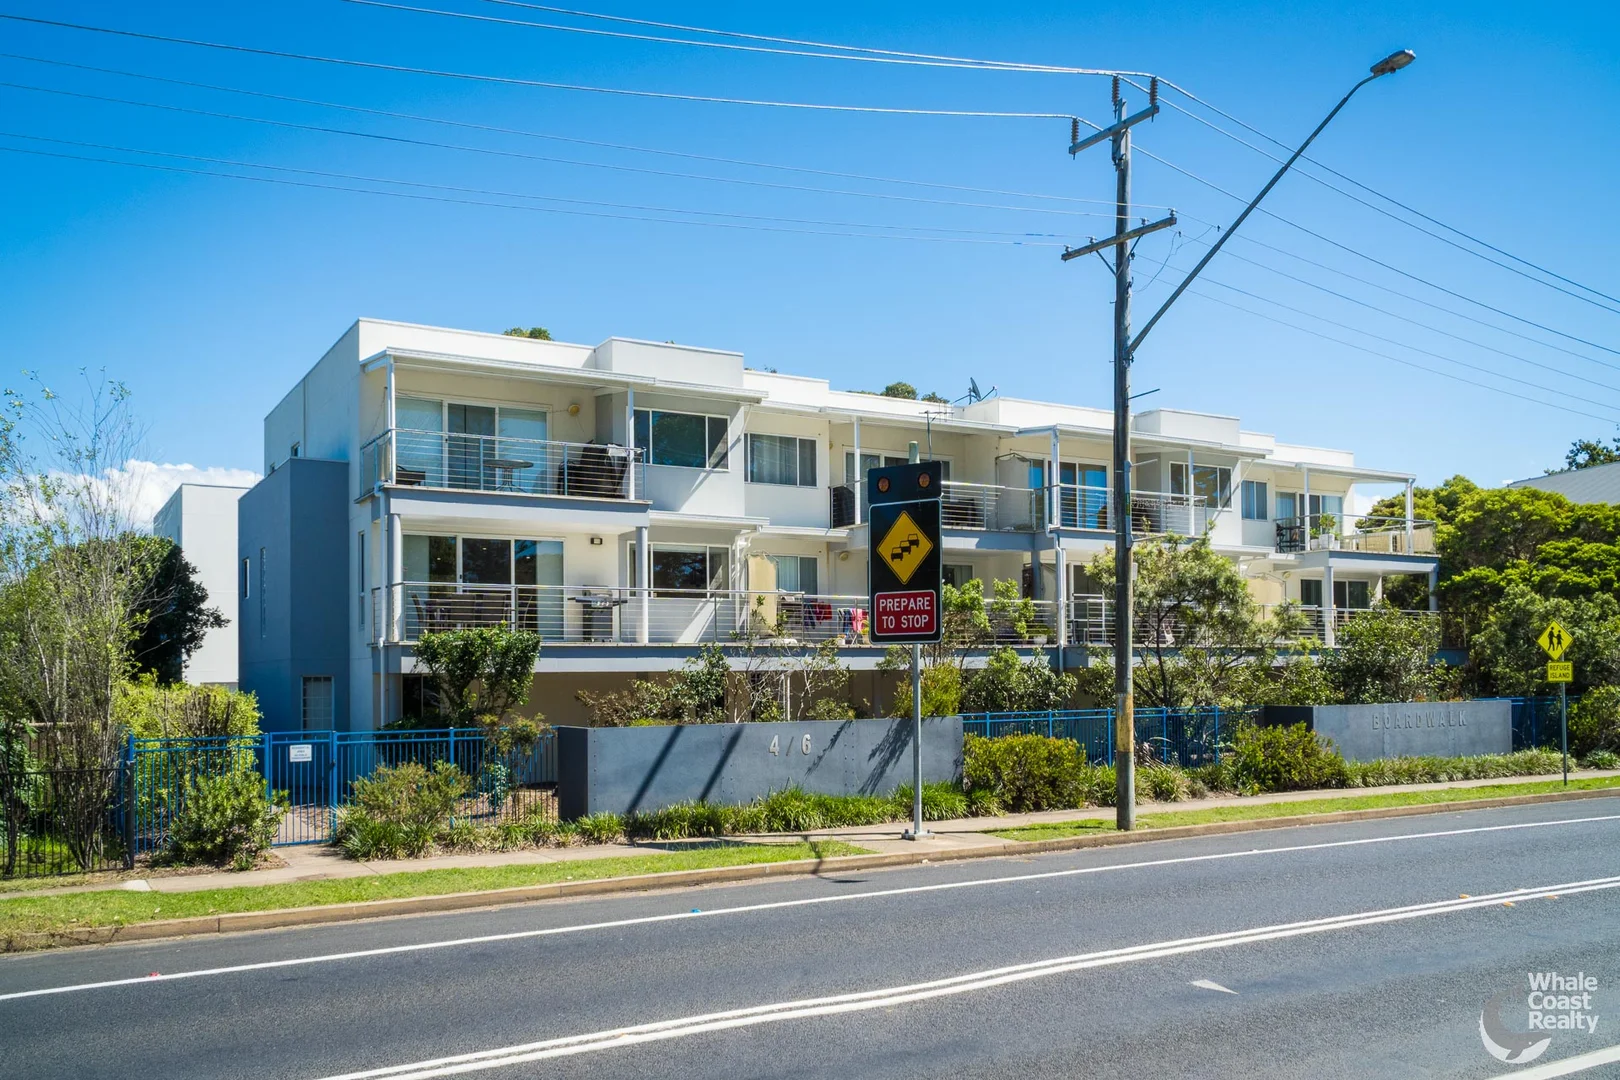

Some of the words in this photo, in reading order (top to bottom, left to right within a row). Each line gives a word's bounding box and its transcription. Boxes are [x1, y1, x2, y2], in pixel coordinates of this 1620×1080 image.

[879, 597, 931, 612] PREPARE
[882, 616, 896, 629] TO
[901, 615, 929, 628] STOP
[1372, 709, 1468, 730] BOARDWALK
